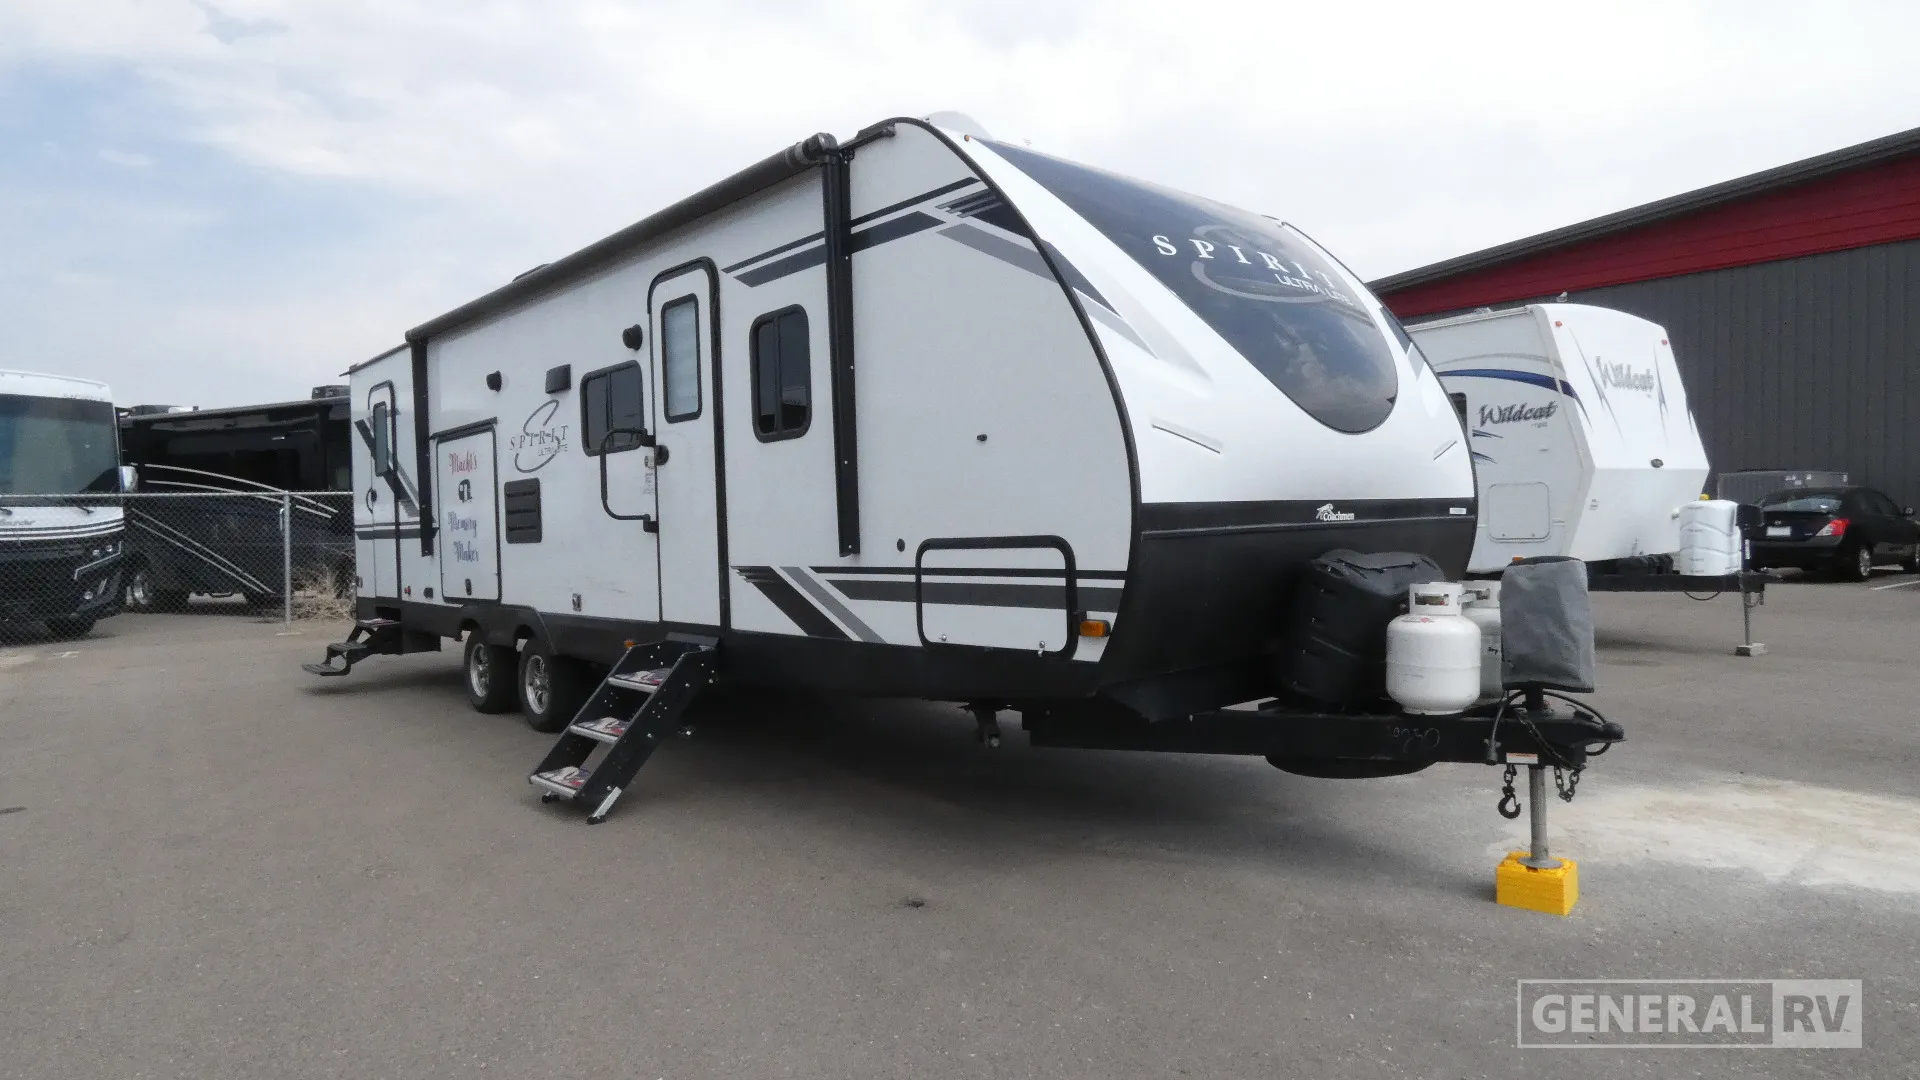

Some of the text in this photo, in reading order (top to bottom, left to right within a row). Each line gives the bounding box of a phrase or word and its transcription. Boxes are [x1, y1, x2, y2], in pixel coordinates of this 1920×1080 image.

[1152, 235, 1336, 289] SPIRIT
[1274, 273, 1326, 296] ULTRA
[1596, 355, 1655, 392] Wildcat
[1478, 400, 1558, 428] Wildcat
[509, 425, 569, 451] SPIRIT
[1323, 510, 1355, 521] Coachmen
